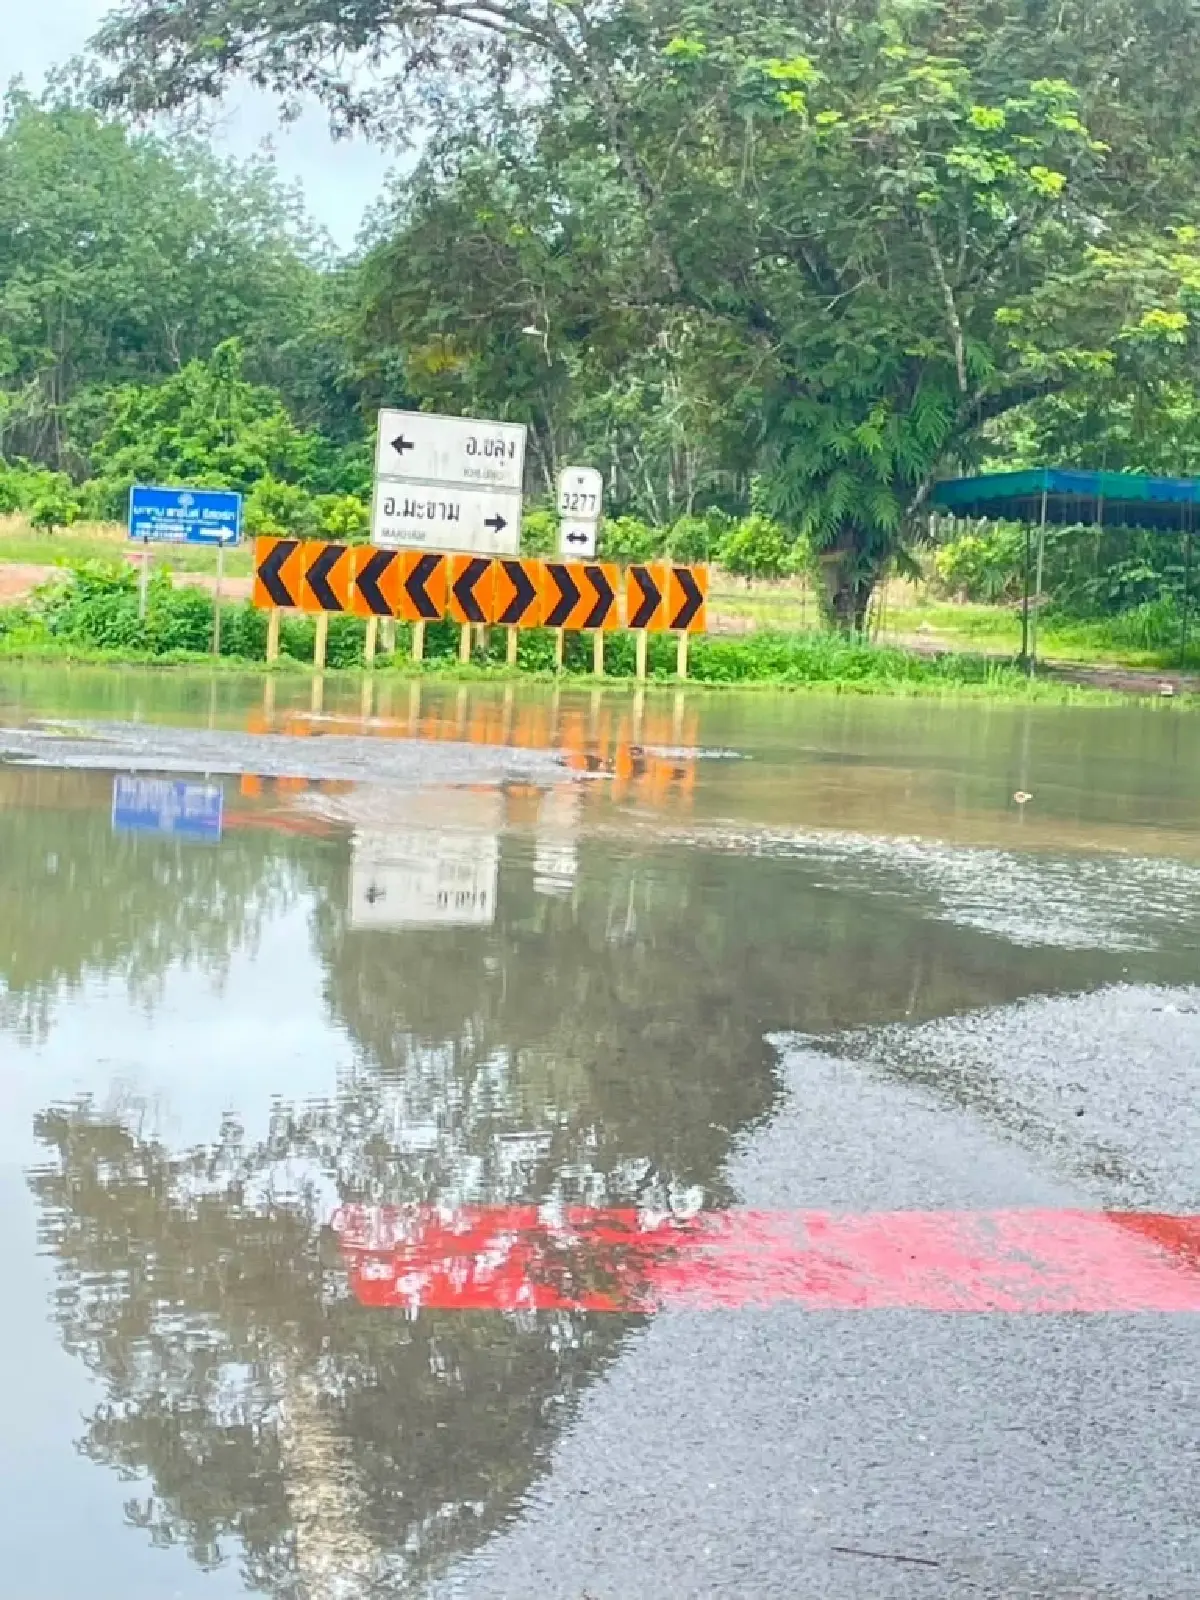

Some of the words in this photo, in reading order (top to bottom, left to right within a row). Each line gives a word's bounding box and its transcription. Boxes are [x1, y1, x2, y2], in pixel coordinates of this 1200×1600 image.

[465, 436, 515, 466] อ.ขลุง
[383, 497, 460, 521] อ.มะขาม
[562, 492, 596, 511] 3277
